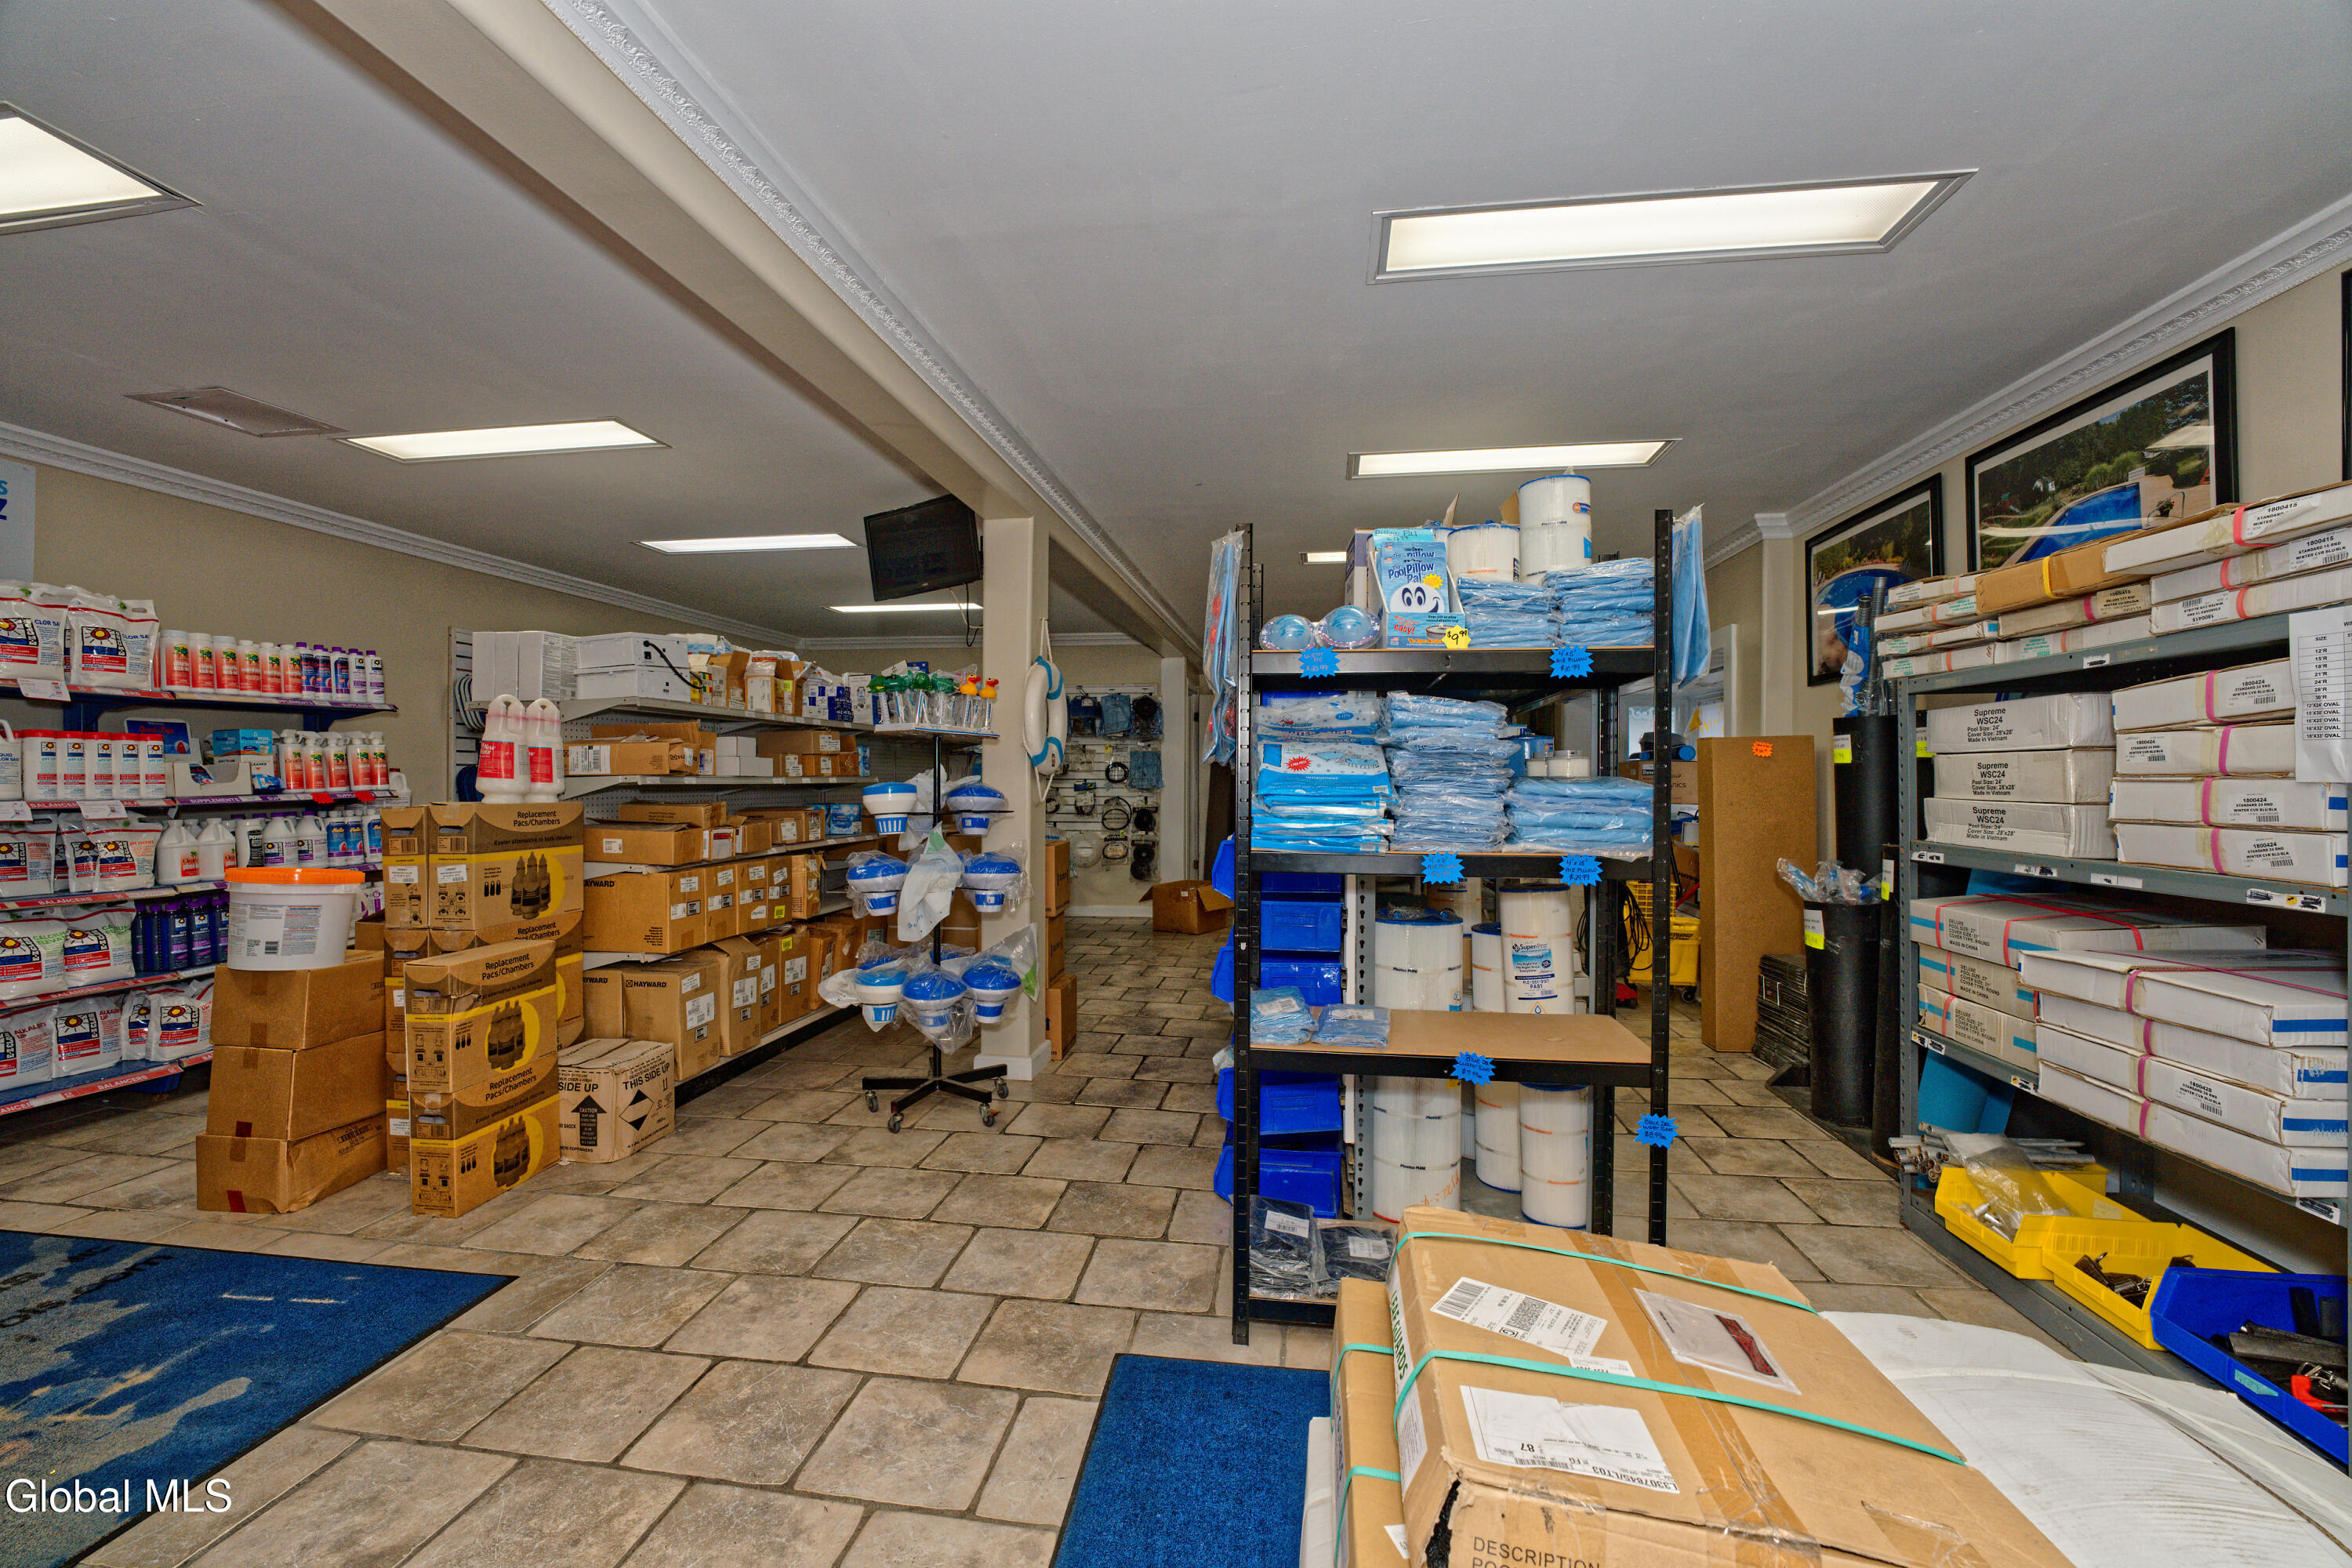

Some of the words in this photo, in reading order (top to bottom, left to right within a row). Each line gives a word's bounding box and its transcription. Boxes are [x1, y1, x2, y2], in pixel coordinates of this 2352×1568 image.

[2268, 502, 2298, 513] 1800415
[2307, 535, 2334, 546] 1800415
[2298, 546, 2323, 554] STANDARD
[1388, 567, 1406, 579] Pool
[1406, 562, 1435, 574] Pillow
[1407, 572, 1422, 583] Pal
[1394, 623, 1415, 635] easy!
[1974, 708, 2006, 717] Supreme
[1976, 716, 2003, 725] WSC24
[1980, 770, 2005, 779] WSC24
[517, 811, 557, 819] Replacement
[1973, 807, 2006, 815] Supreme
[514, 818, 561, 827] Pacs/Chambers
[1976, 815, 2005, 824] WSC24
[517, 921, 557, 935] Replacement
[485, 953, 529, 970] Replacement
[481, 960, 534, 981] Pacs/Chambers
[51, 986, 104, 998] BALANCERS
[489, 1067, 533, 1091] Replacement
[622, 1076, 644, 1090] THIS
[644, 1069, 661, 1082] SIDE
[662, 1063, 670, 1073] UP
[97, 1075, 148, 1090] BALANCERS
[558, 1082, 581, 1091] SIDE
[584, 1083, 598, 1092] UP
[485, 1076, 537, 1102] Pacs/Chambers
[1391, 1290, 1402, 1321] LEAF
[1392, 1320, 1408, 1381] GUARDS
[1519, 1443, 1534, 1452] 87
[1592, 1465, 1679, 1491] L3307845/LT03
